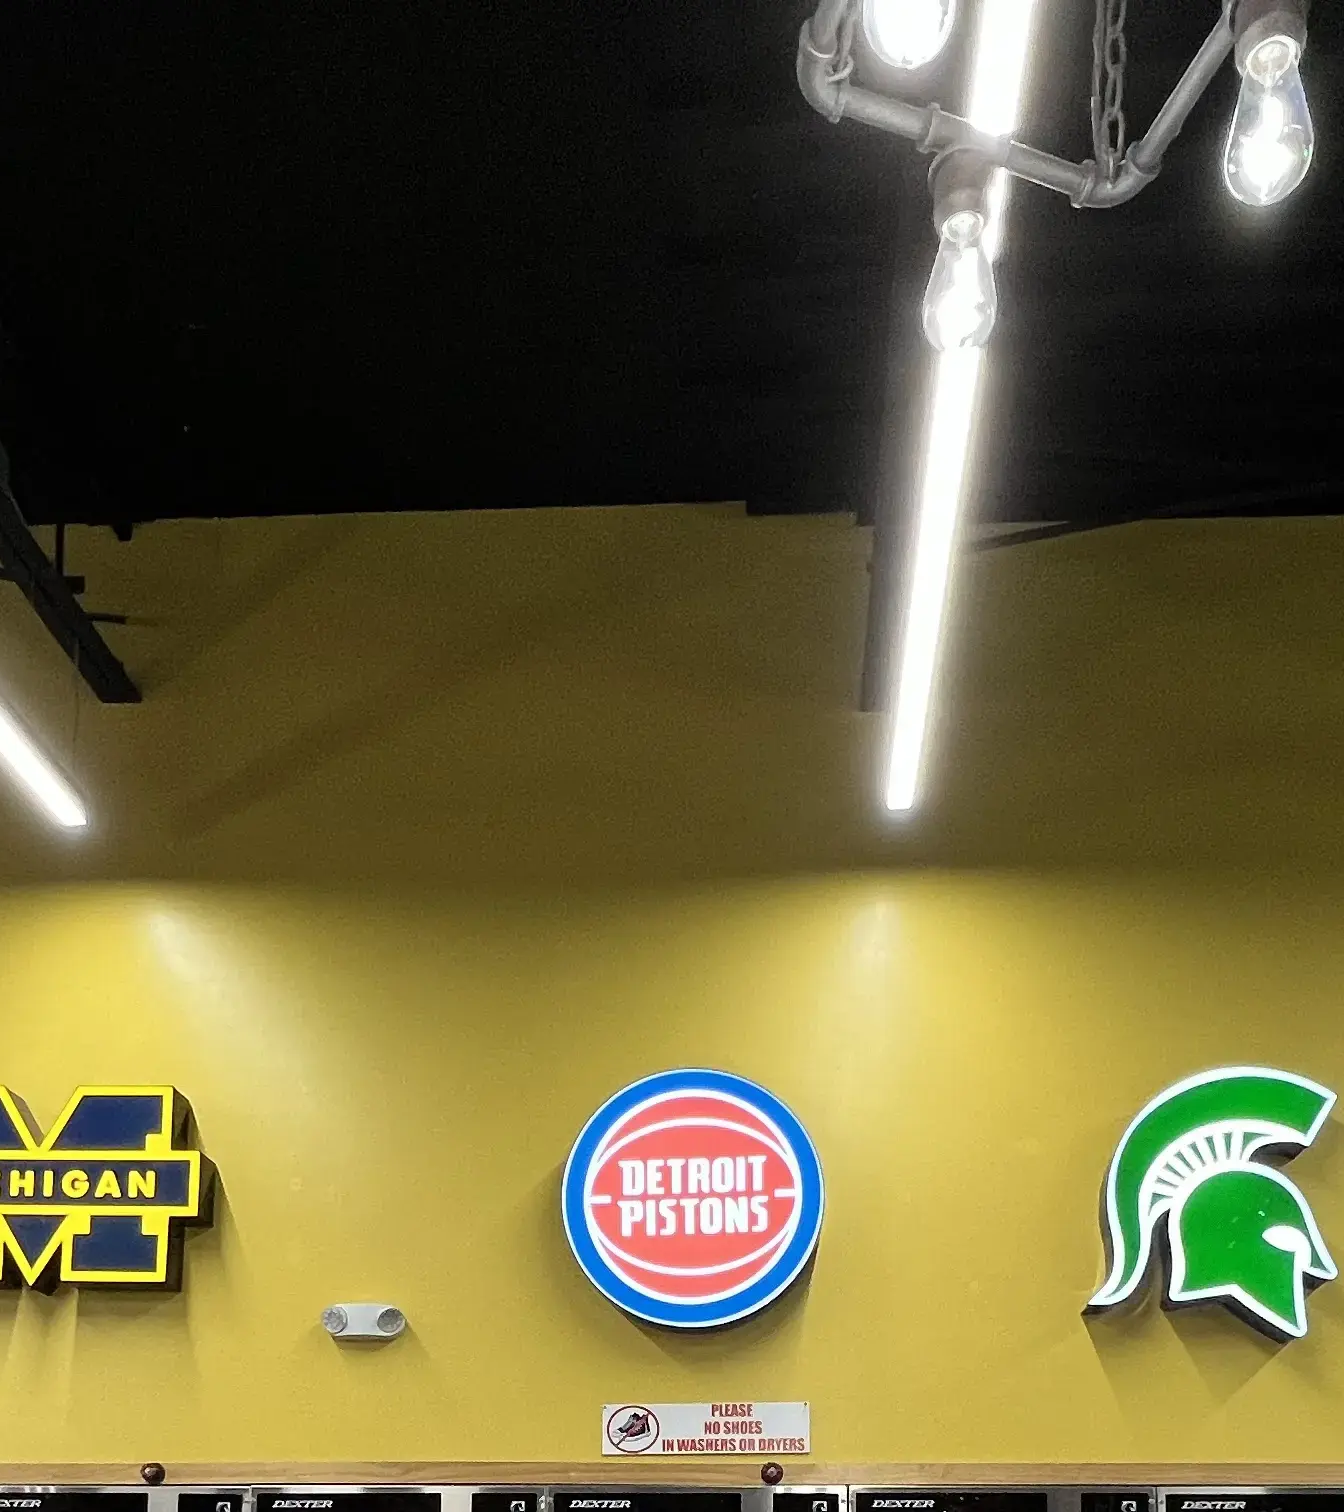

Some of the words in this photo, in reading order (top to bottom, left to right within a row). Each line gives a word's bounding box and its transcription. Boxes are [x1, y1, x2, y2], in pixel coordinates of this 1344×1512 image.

[617, 1154, 768, 1197] DETROIT
[616, 1195, 769, 1237] PISTONS
[710, 1403, 754, 1418] PLEASE
[703, 1421, 721, 1435] NO
[723, 1420, 763, 1435] SHOES
[661, 1439, 675, 1452] IN
[676, 1438, 736, 1453] WASHERS
[738, 1438, 756, 1451] OR
[757, 1437, 806, 1452] DRYERS
[271, 1499, 334, 1509] DEXTER
[569, 1499, 632, 1509] DEXTER
[871, 1499, 936, 1509] DEXTER
[1180, 1500, 1247, 1510] DEXTER
